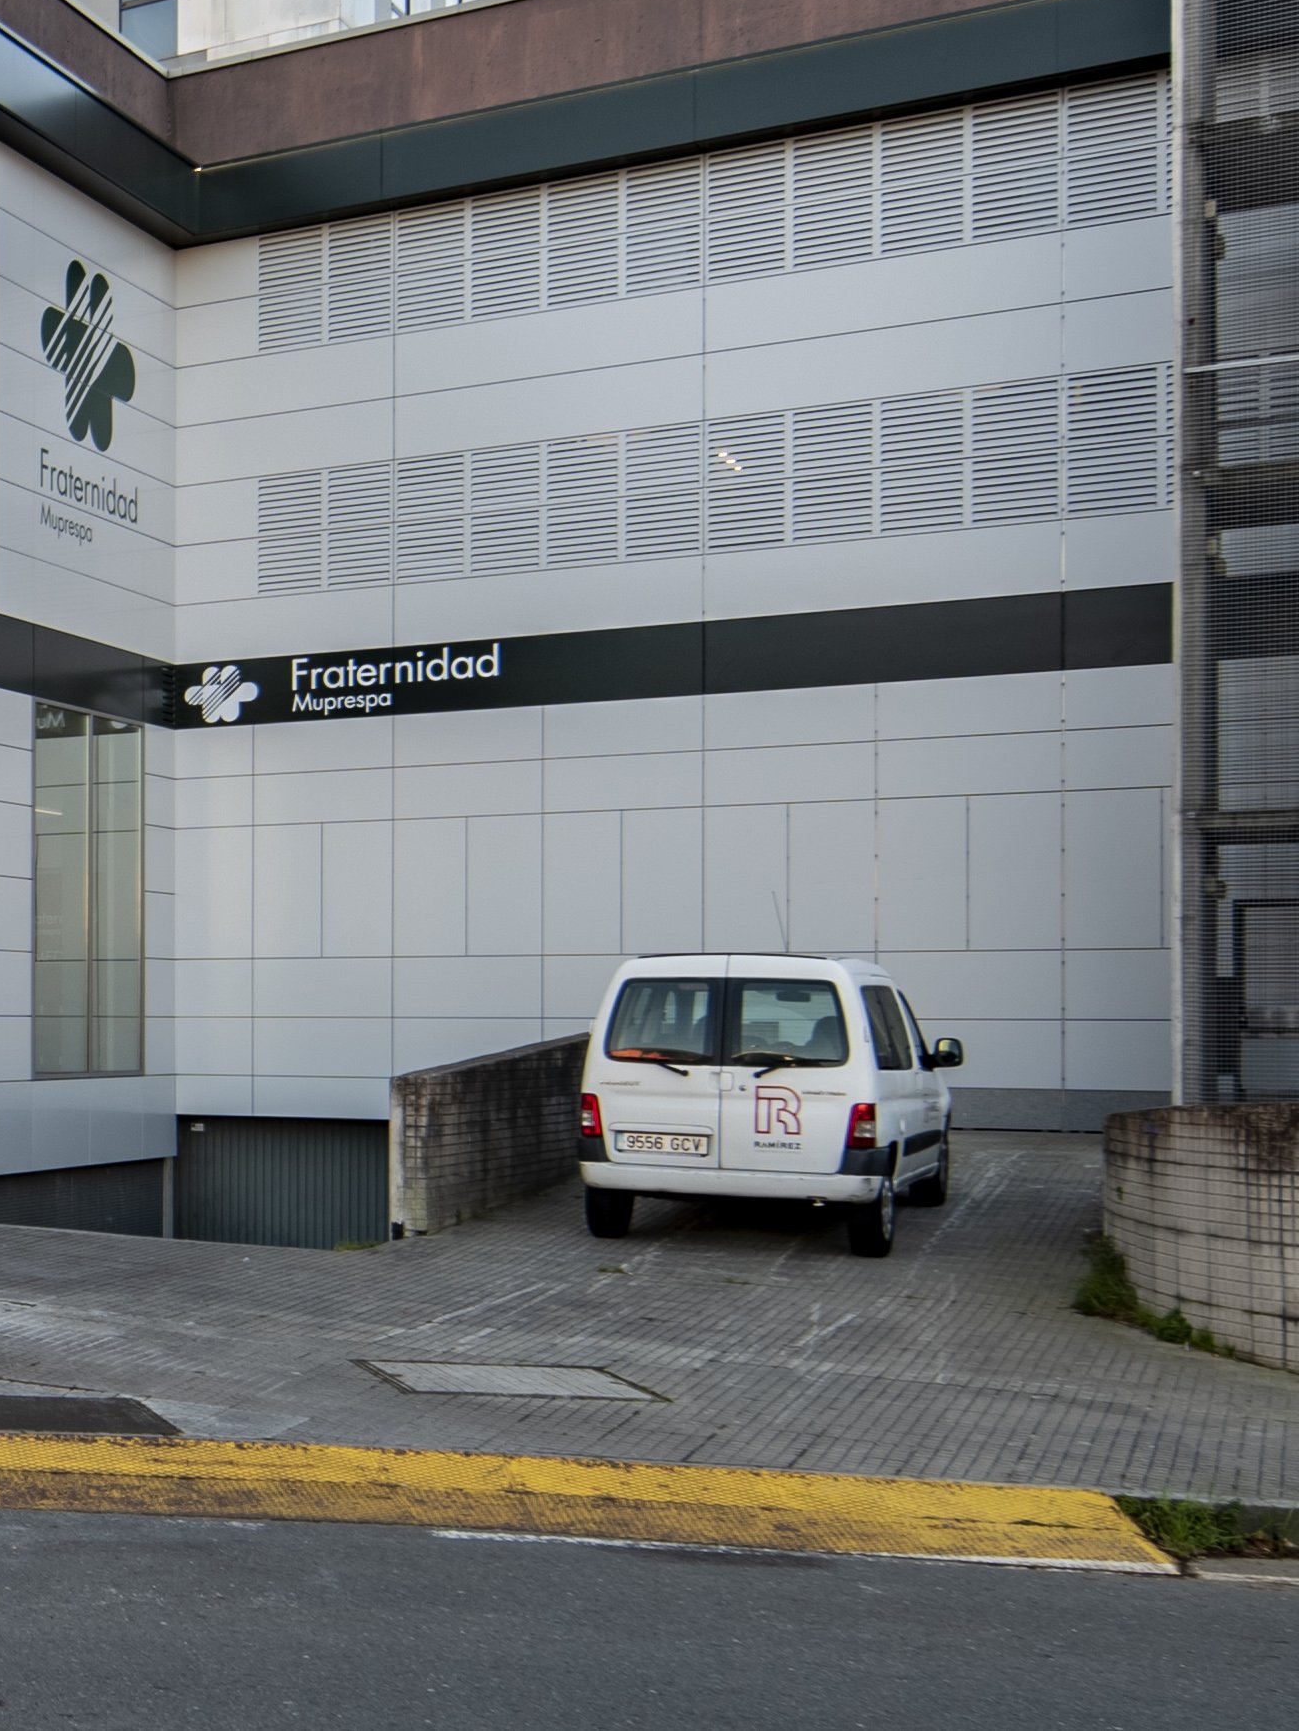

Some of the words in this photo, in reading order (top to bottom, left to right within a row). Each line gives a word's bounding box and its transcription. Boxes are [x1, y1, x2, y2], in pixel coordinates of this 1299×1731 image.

[40, 447, 138, 525] Fraternidad
[40, 504, 93, 546] Muprespa
[291, 642, 500, 691] Fraternidad
[291, 692, 392, 716] Muprespa
[626, 1135, 664, 1150] 9556
[670, 1137, 702, 1152] GCV
[753, 1140, 802, 1150] RAMÍREZ
